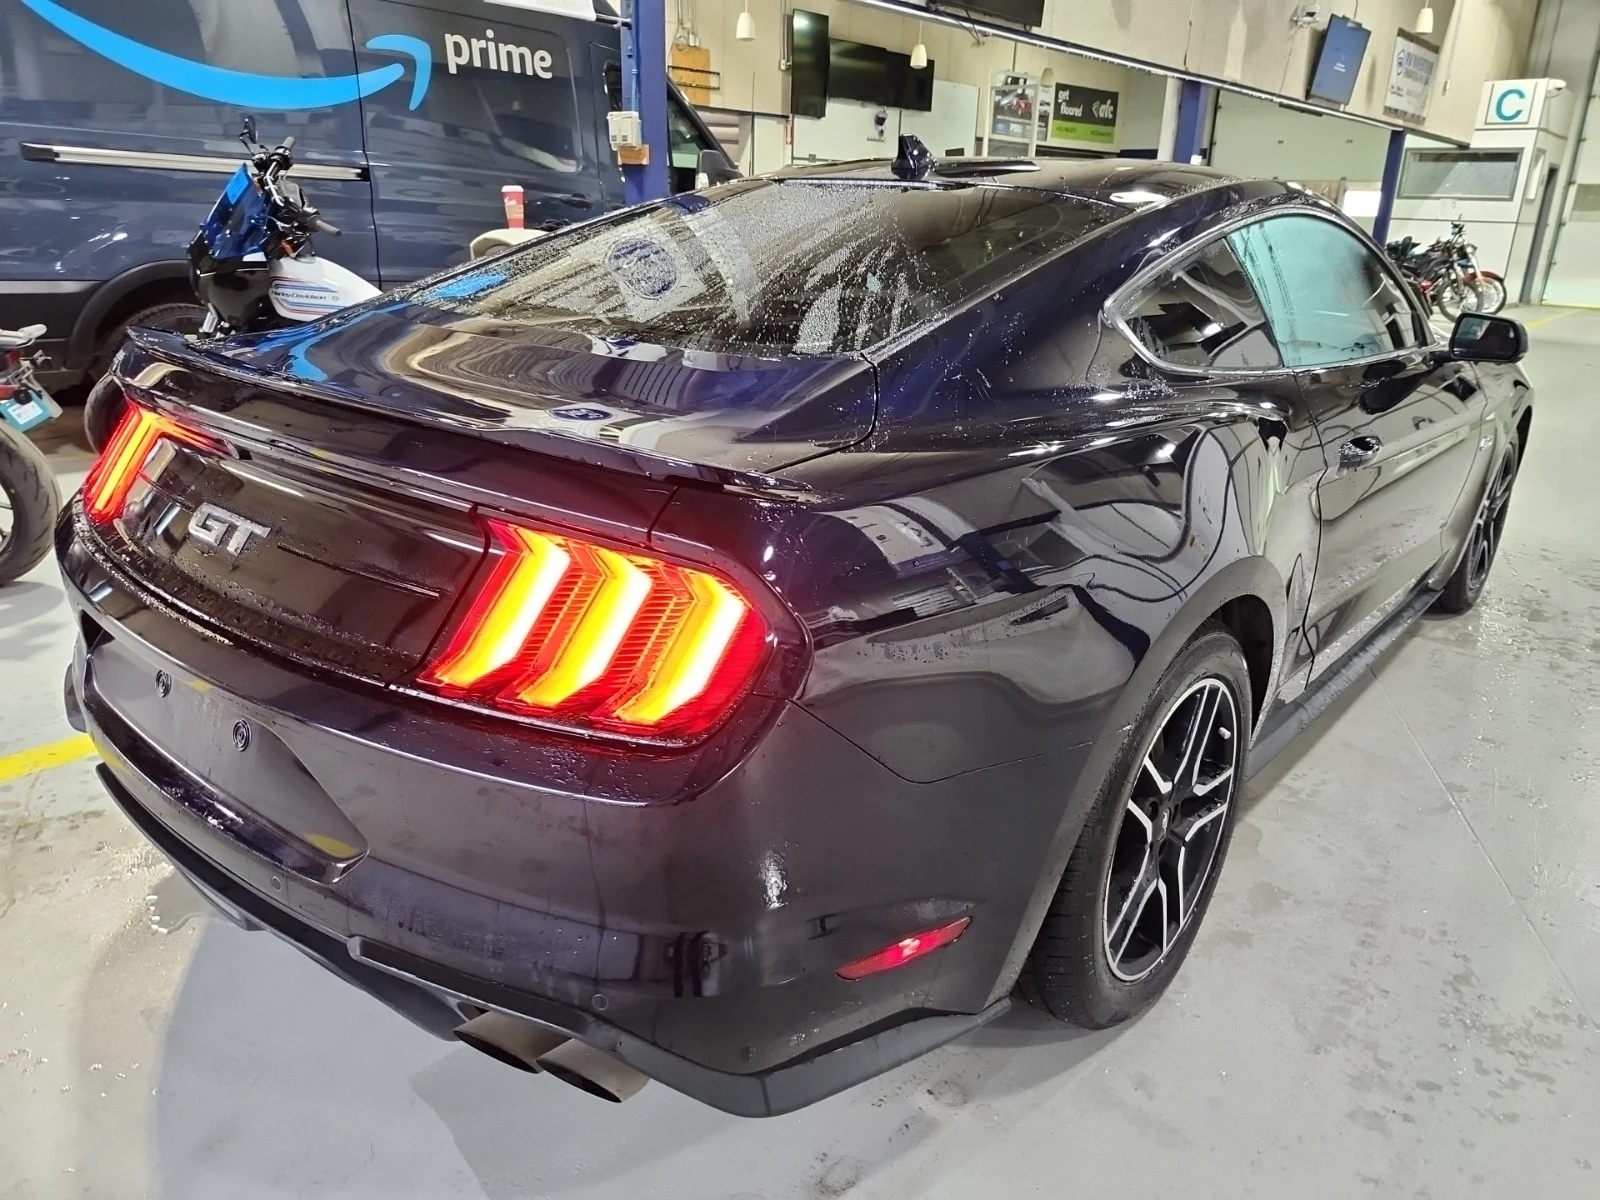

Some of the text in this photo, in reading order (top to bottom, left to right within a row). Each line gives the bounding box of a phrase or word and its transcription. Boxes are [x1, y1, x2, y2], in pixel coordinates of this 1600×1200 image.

[444, 28, 553, 79] prime
[1057, 89, 1069, 103] get
[1495, 88, 1525, 121] C
[188, 501, 272, 557] GT
